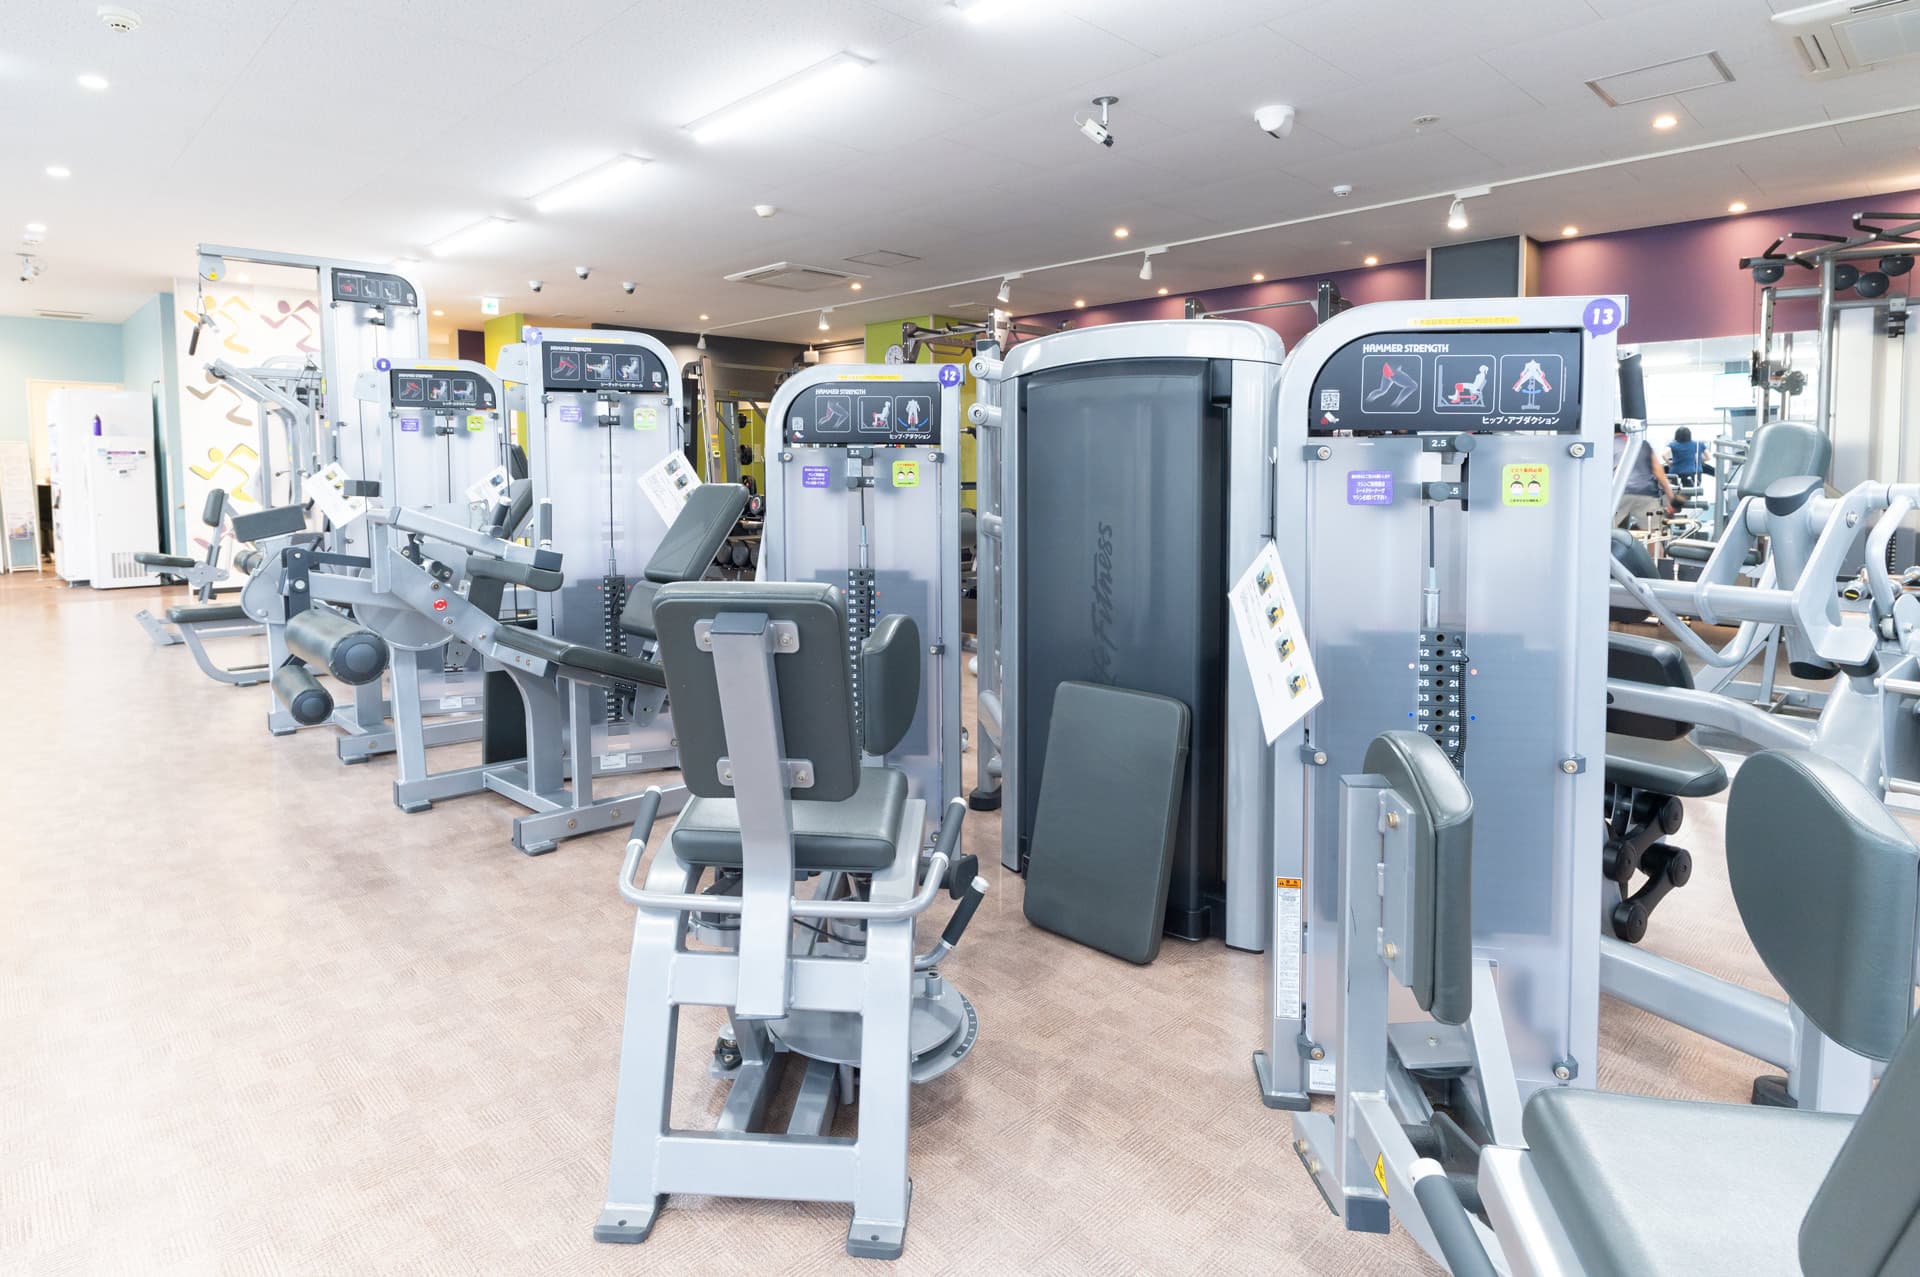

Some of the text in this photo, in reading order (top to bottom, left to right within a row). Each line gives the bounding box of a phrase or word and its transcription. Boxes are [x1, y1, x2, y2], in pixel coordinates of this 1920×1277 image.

[1593, 307, 1614, 325] 13
[1363, 344, 1449, 353] HAMMER STRENGTH
[944, 371, 956, 381] 12
[1482, 416, 1560, 425] ヒップ・アブダクション
[1431, 439, 1447, 448] 2.5
[1450, 487, 1459, 495] .5
[1091, 521, 1118, 651] Fitness
[1419, 634, 1426, 642] 5
[1450, 649, 1462, 657] 12
[1419, 664, 1429, 672] 19
[1418, 679, 1430, 687] 26
[1418, 709, 1429, 717] 40
[1418, 724, 1429, 732] 47
